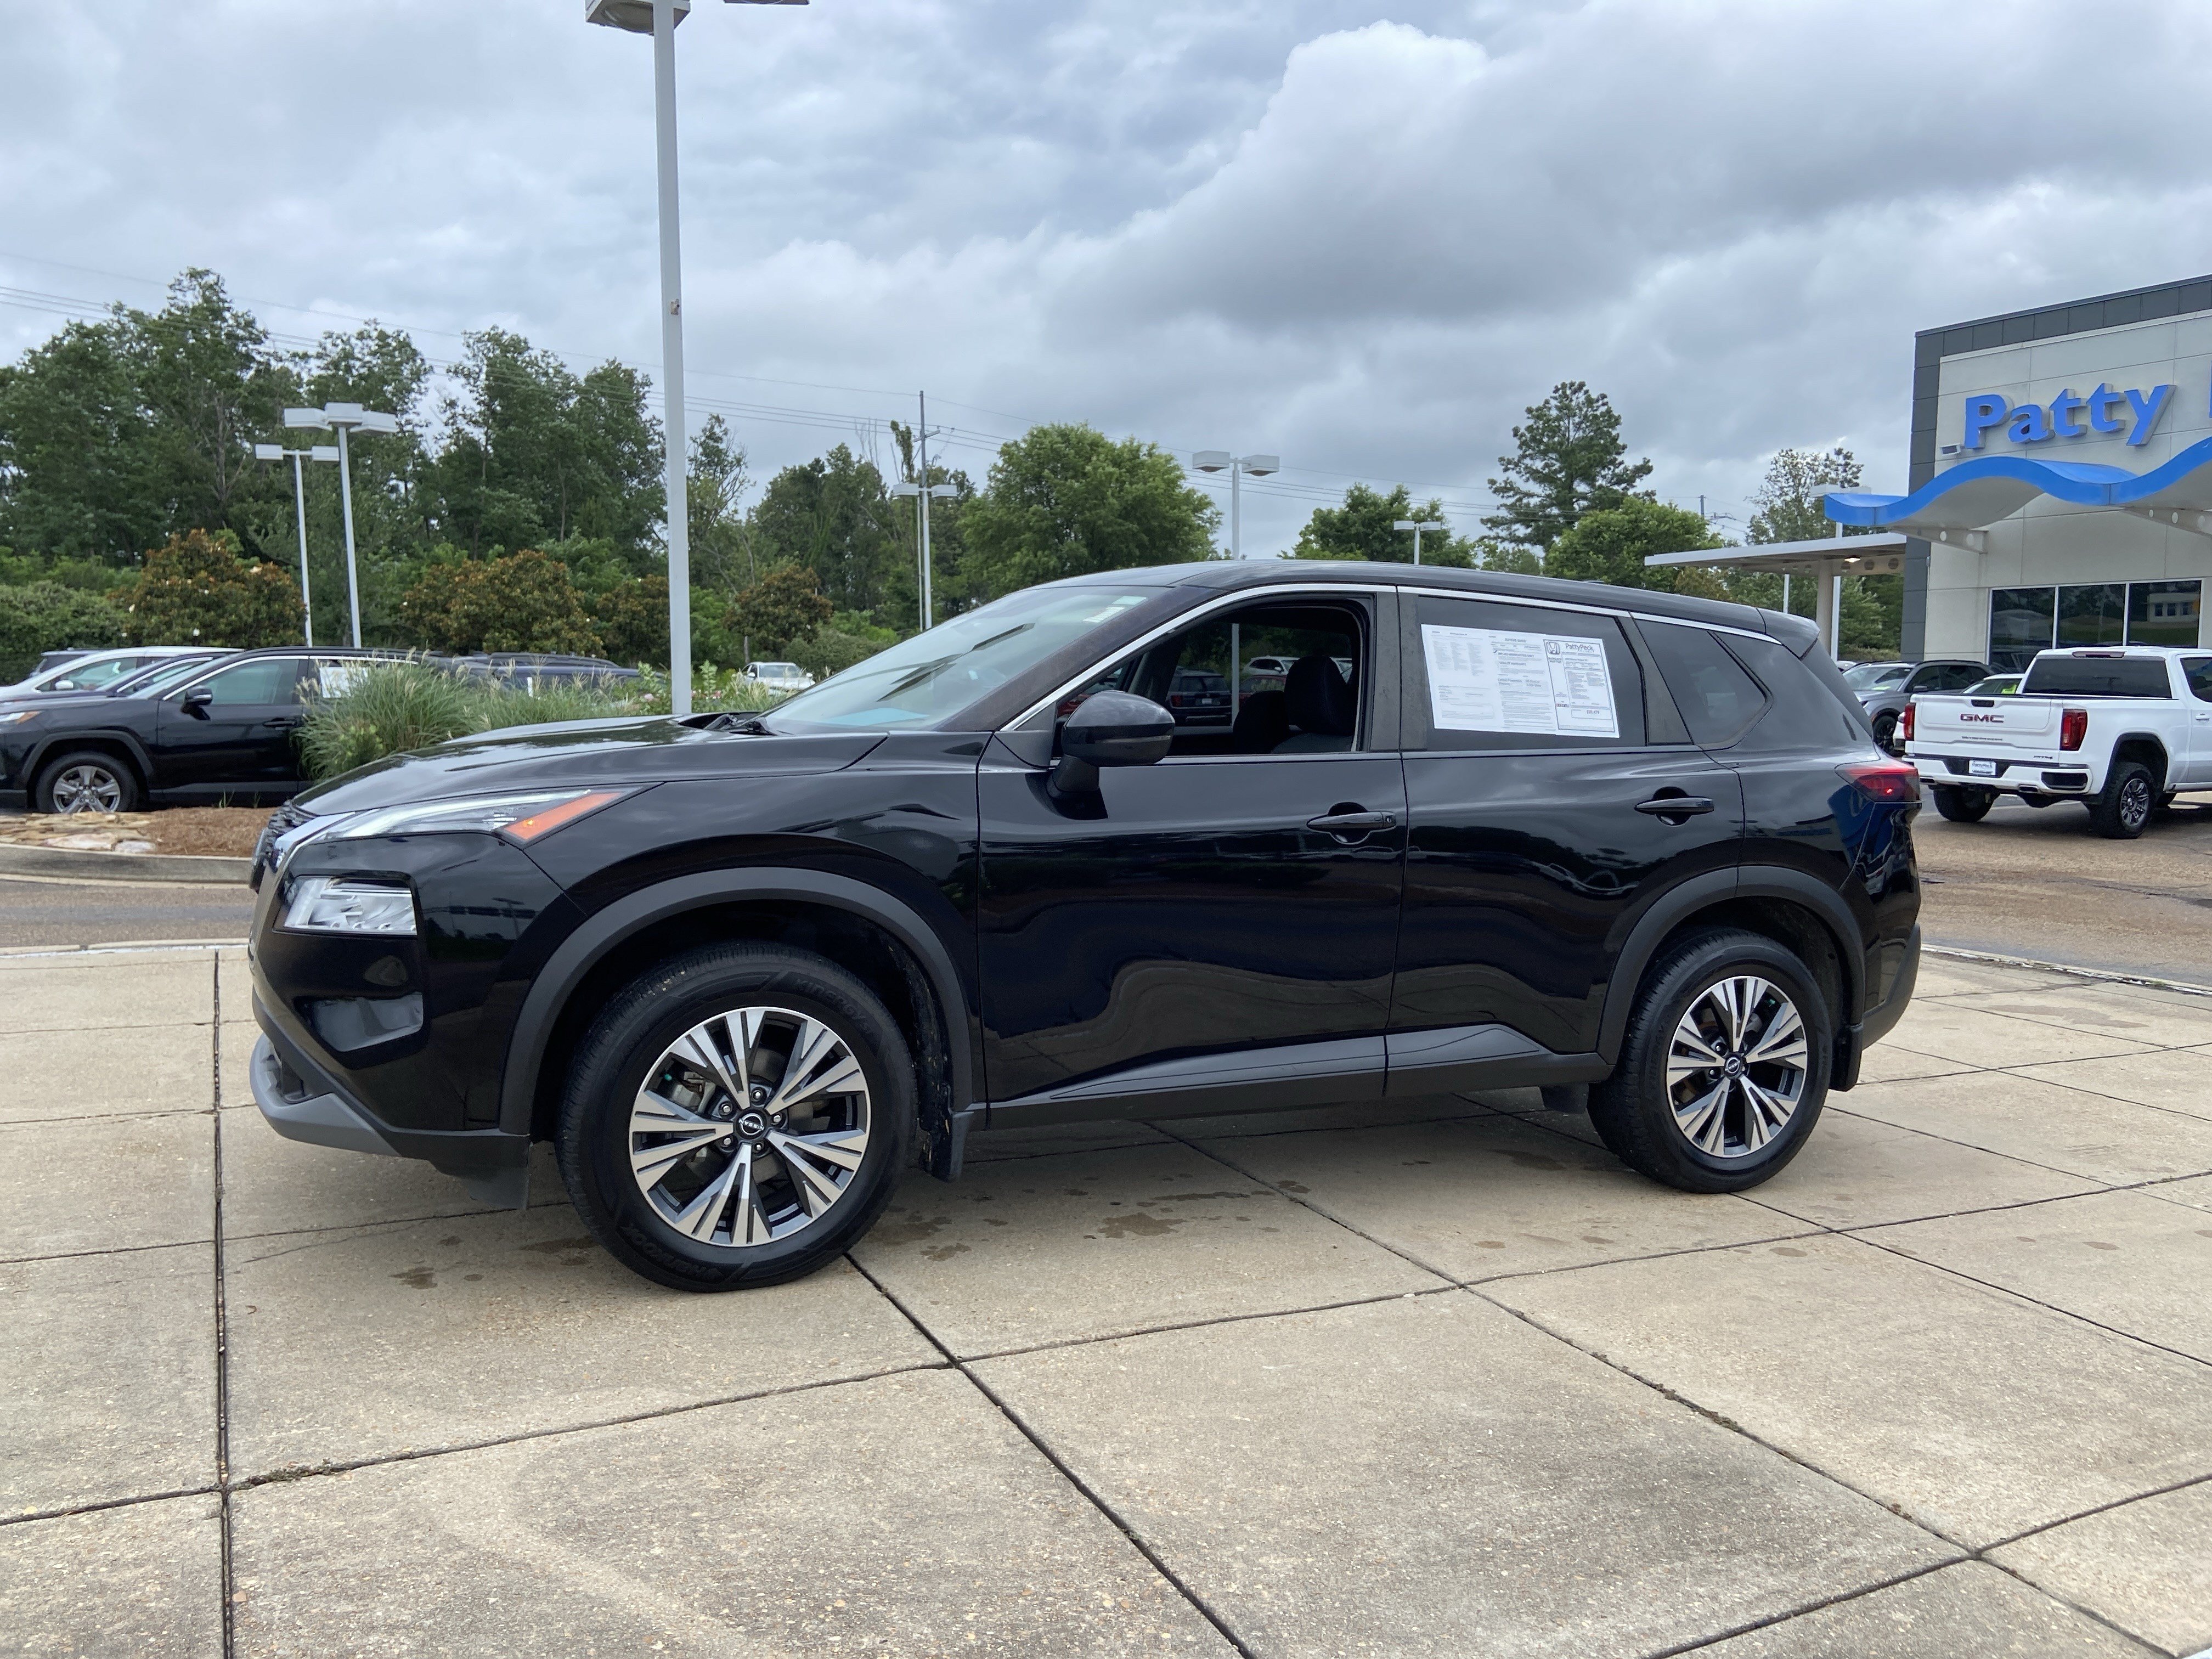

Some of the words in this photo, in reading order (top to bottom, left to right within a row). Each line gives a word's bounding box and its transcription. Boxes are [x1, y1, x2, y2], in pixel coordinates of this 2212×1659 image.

[1964, 382, 2177, 449] Patty
[1565, 642, 1594, 652] PattyPeck
[1960, 713, 2004, 723] GMC
[738, 1118, 765, 1131] NISSAN
